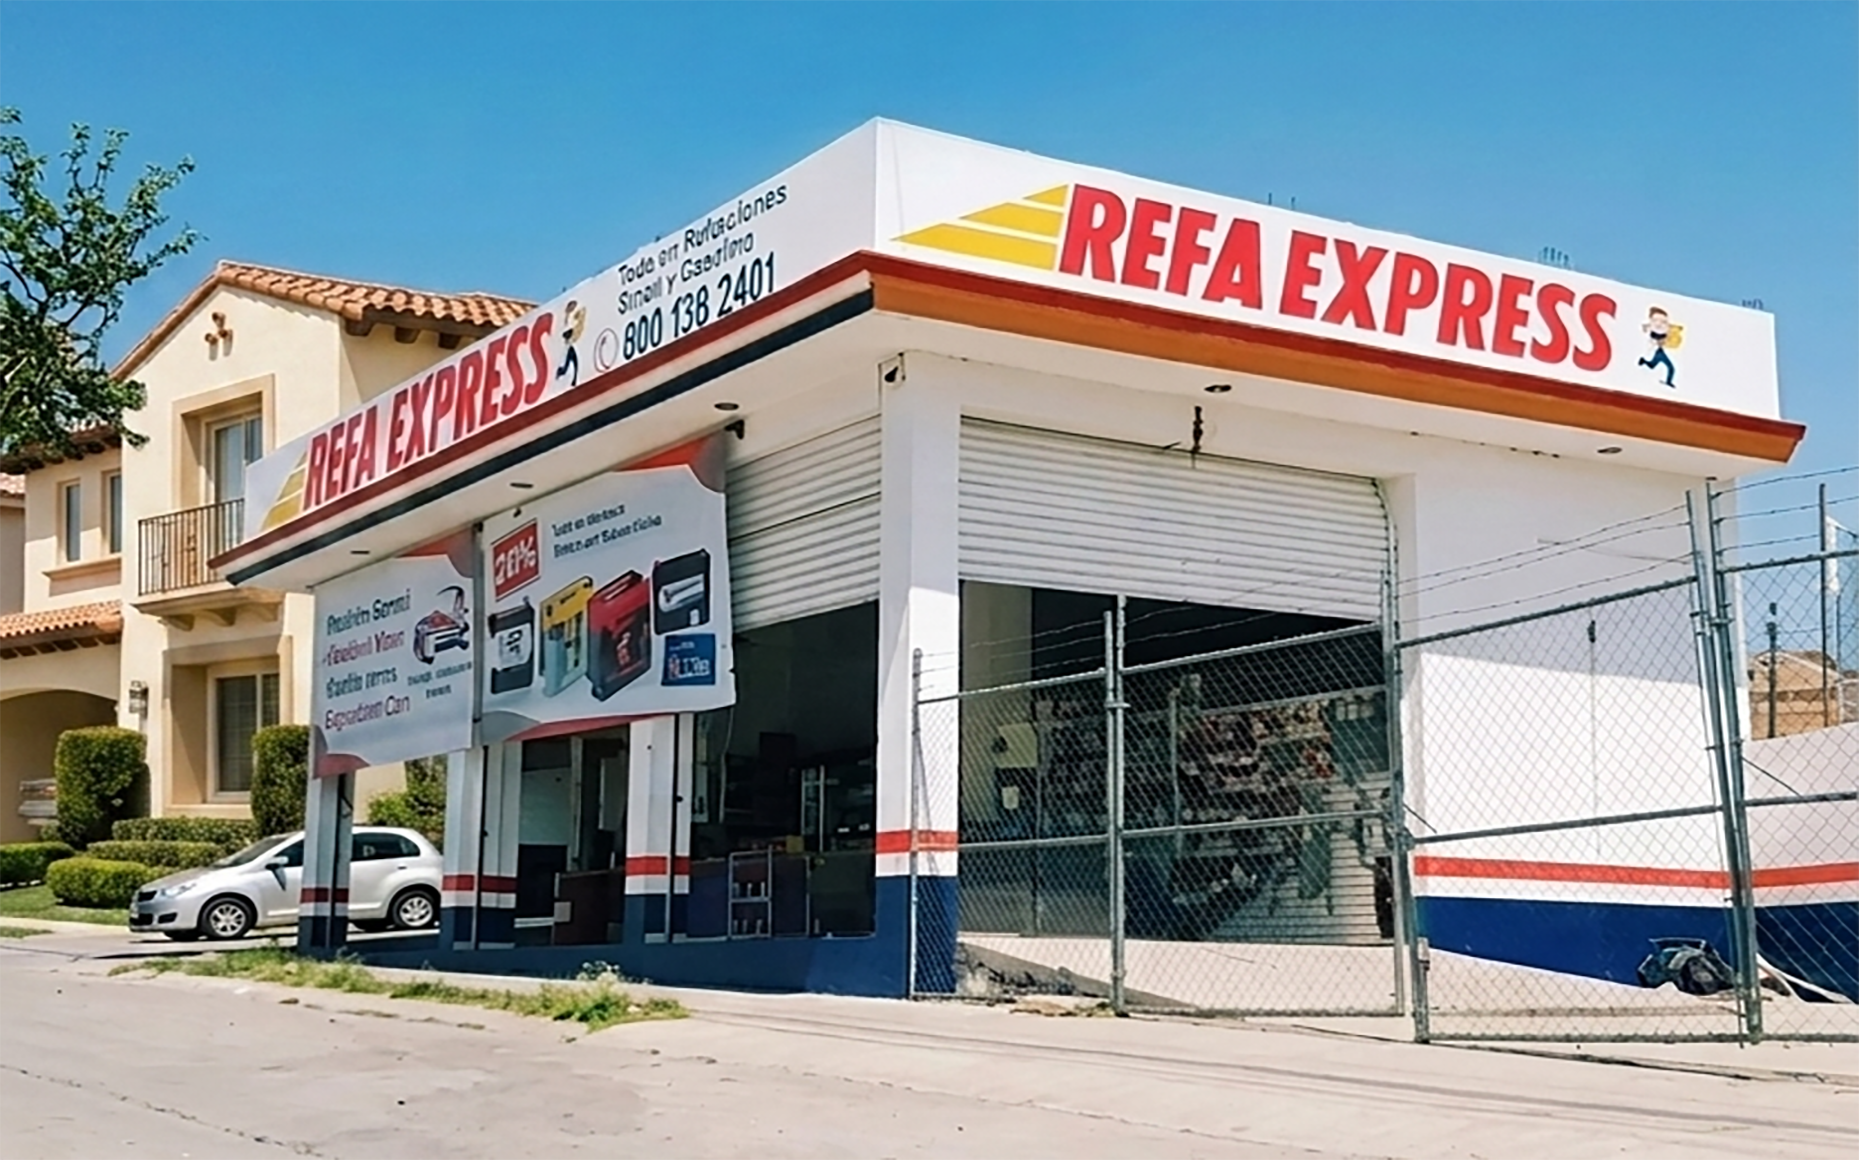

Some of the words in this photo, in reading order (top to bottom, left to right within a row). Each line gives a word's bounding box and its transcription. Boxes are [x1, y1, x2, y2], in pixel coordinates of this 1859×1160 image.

[623, 307, 662, 361] 800
[670, 285, 710, 338] 138
[717, 251, 776, 318] 2401
[1058, 183, 1264, 311] REFA
[1277, 229, 1618, 373] EXPRESS
[303, 404, 379, 512] REFA
[386, 312, 555, 475] EXPRESS
